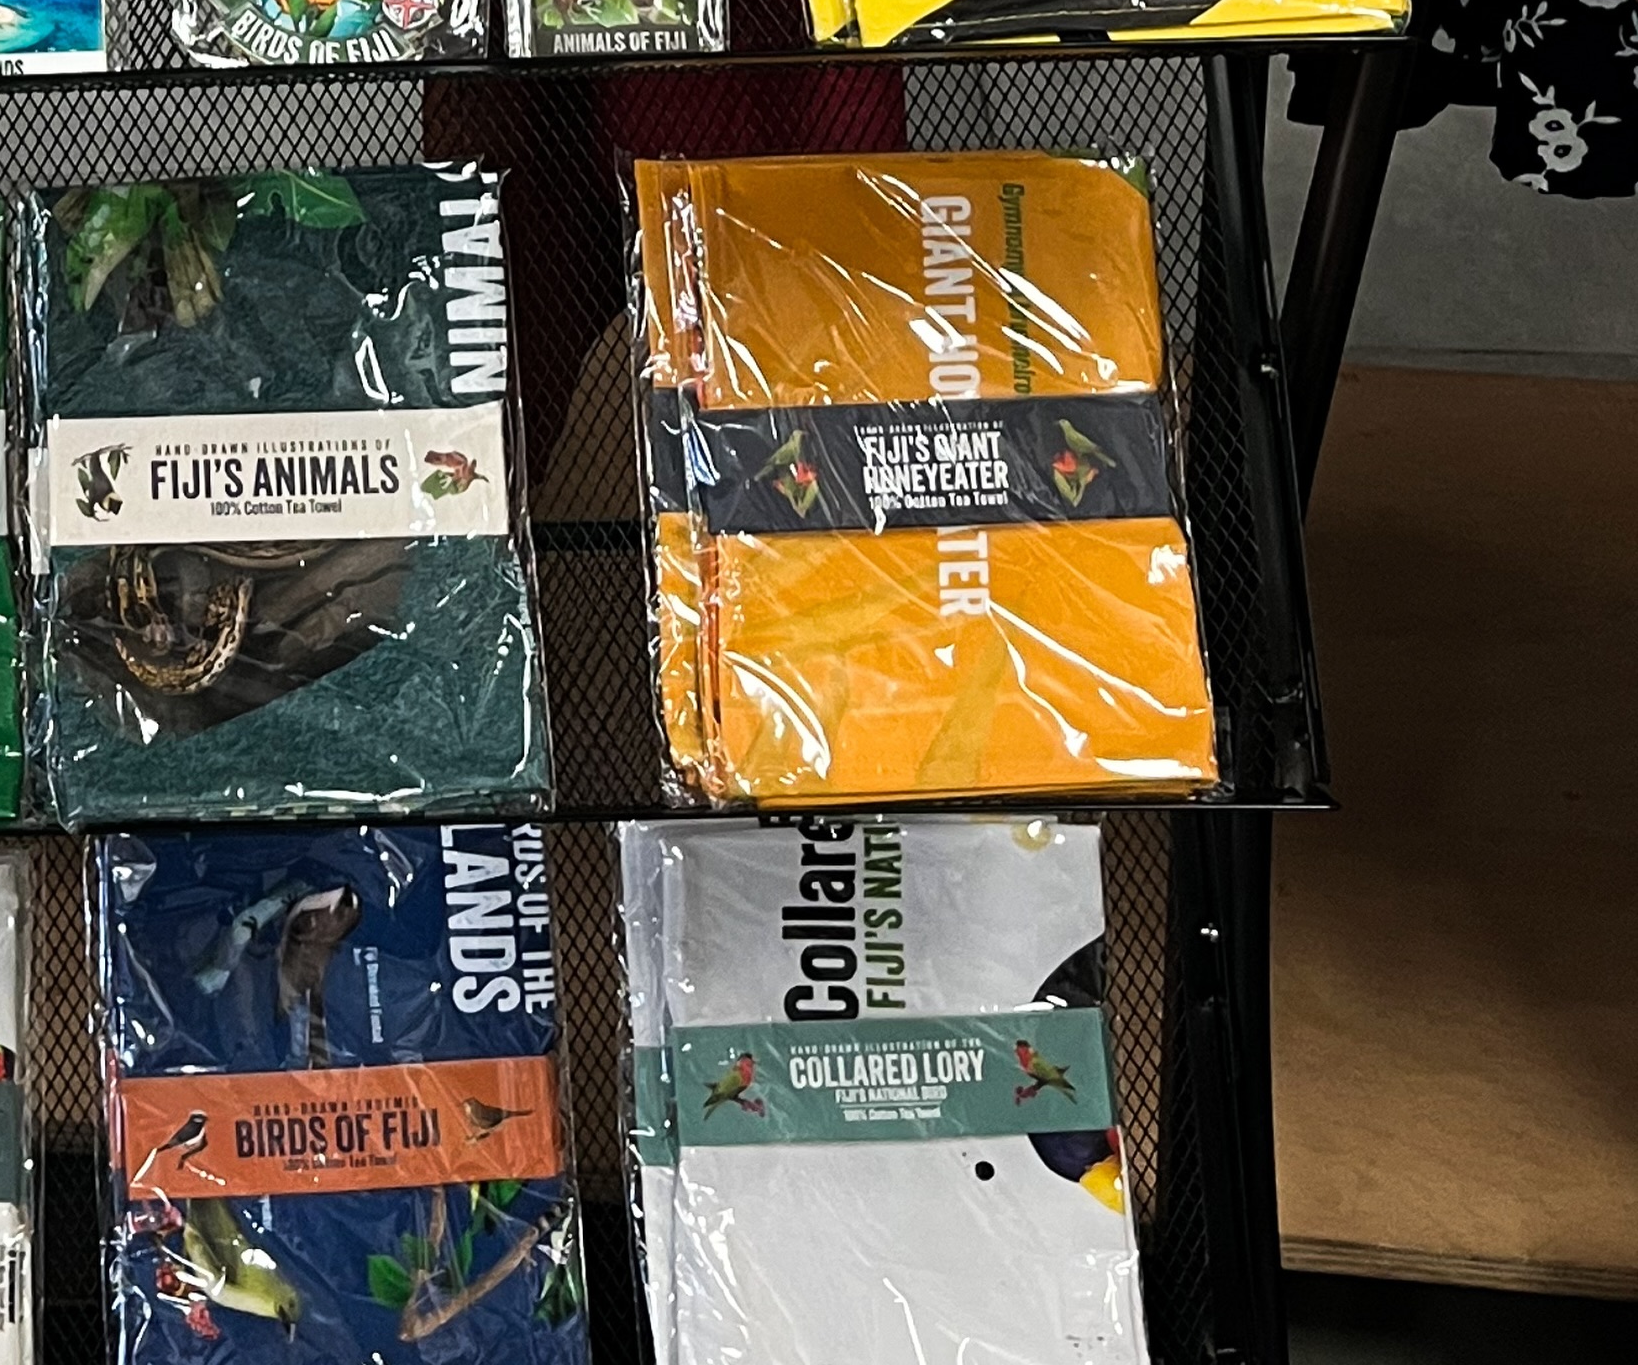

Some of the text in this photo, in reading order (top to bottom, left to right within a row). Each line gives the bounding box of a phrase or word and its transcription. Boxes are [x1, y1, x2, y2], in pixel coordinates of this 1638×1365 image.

[231, 9, 303, 64] BIRDS
[346, 29, 400, 63] FIJI
[554, 31, 687, 54] ANIMALS OF FIJI
[921, 196, 976, 323] GIANT
[151, 454, 400, 500] FIJI'S ANIMALS
[211, 498, 342, 516] 100% Cotton Tea Towel
[864, 909, 906, 1009] FIJI'S
[789, 1049, 984, 1089] COLLARED LORY
[236, 1108, 441, 1158] BIRDS OF FIJI
